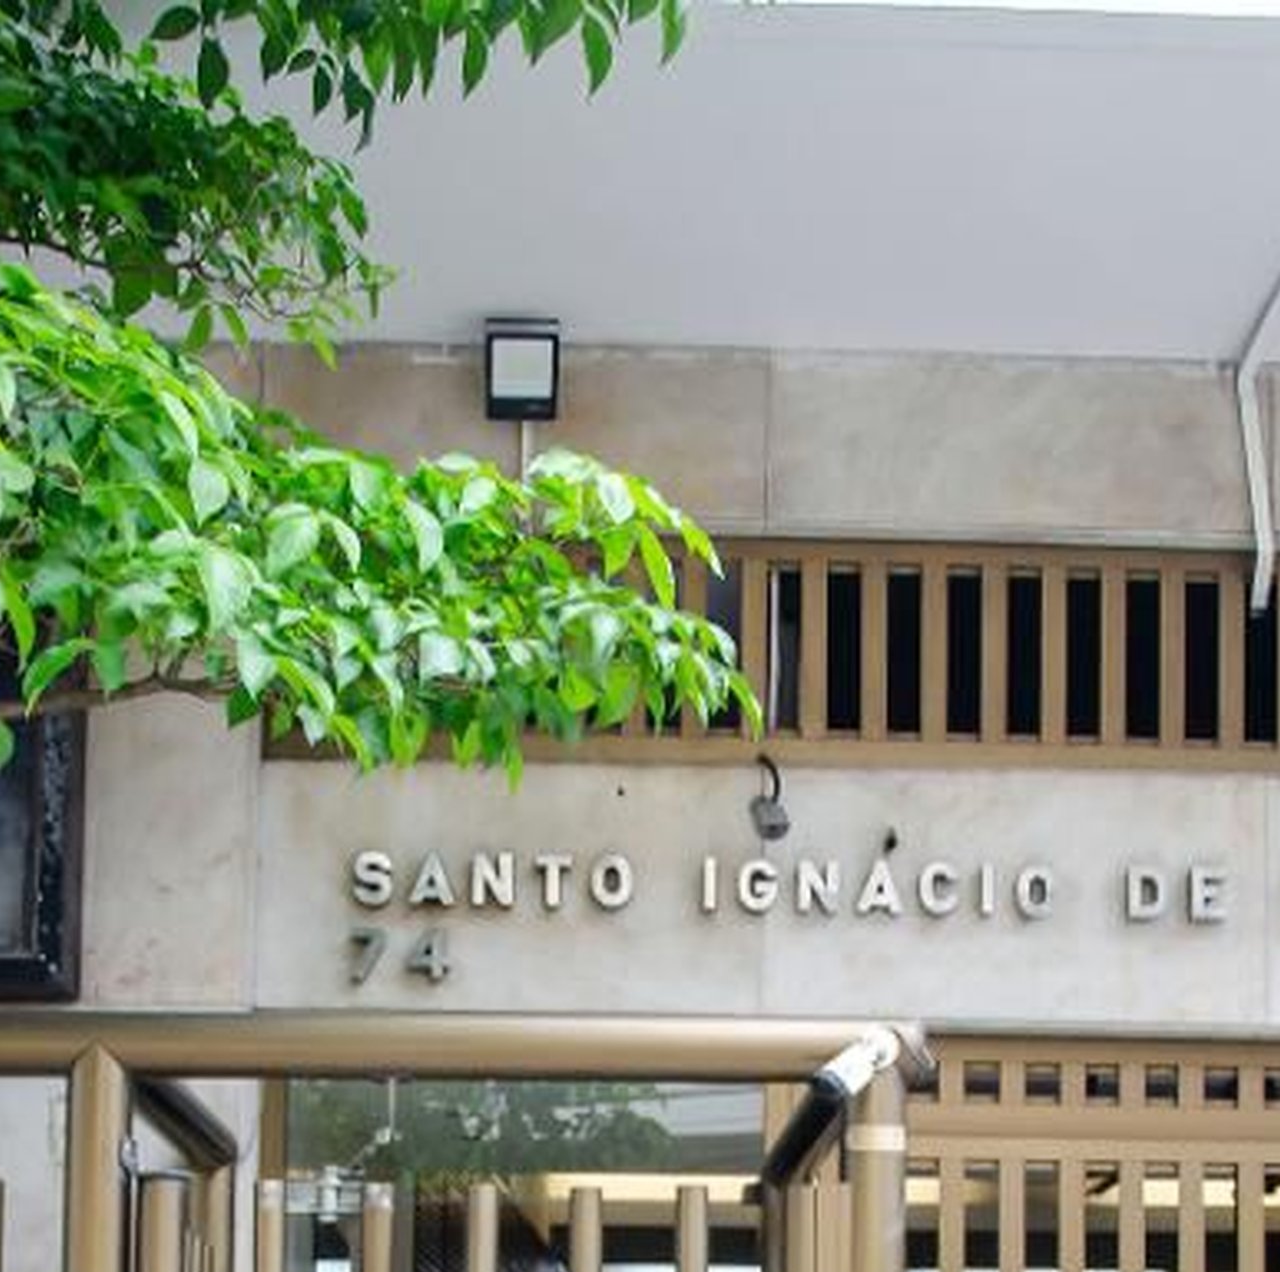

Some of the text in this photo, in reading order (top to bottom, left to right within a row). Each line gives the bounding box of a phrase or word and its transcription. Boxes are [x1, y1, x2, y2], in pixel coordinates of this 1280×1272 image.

[351, 850, 633, 909] SANTO
[699, 828, 1054, 918] IGNÁCIO
[1124, 866, 1228, 925] DE
[348, 927, 450, 986] 74
